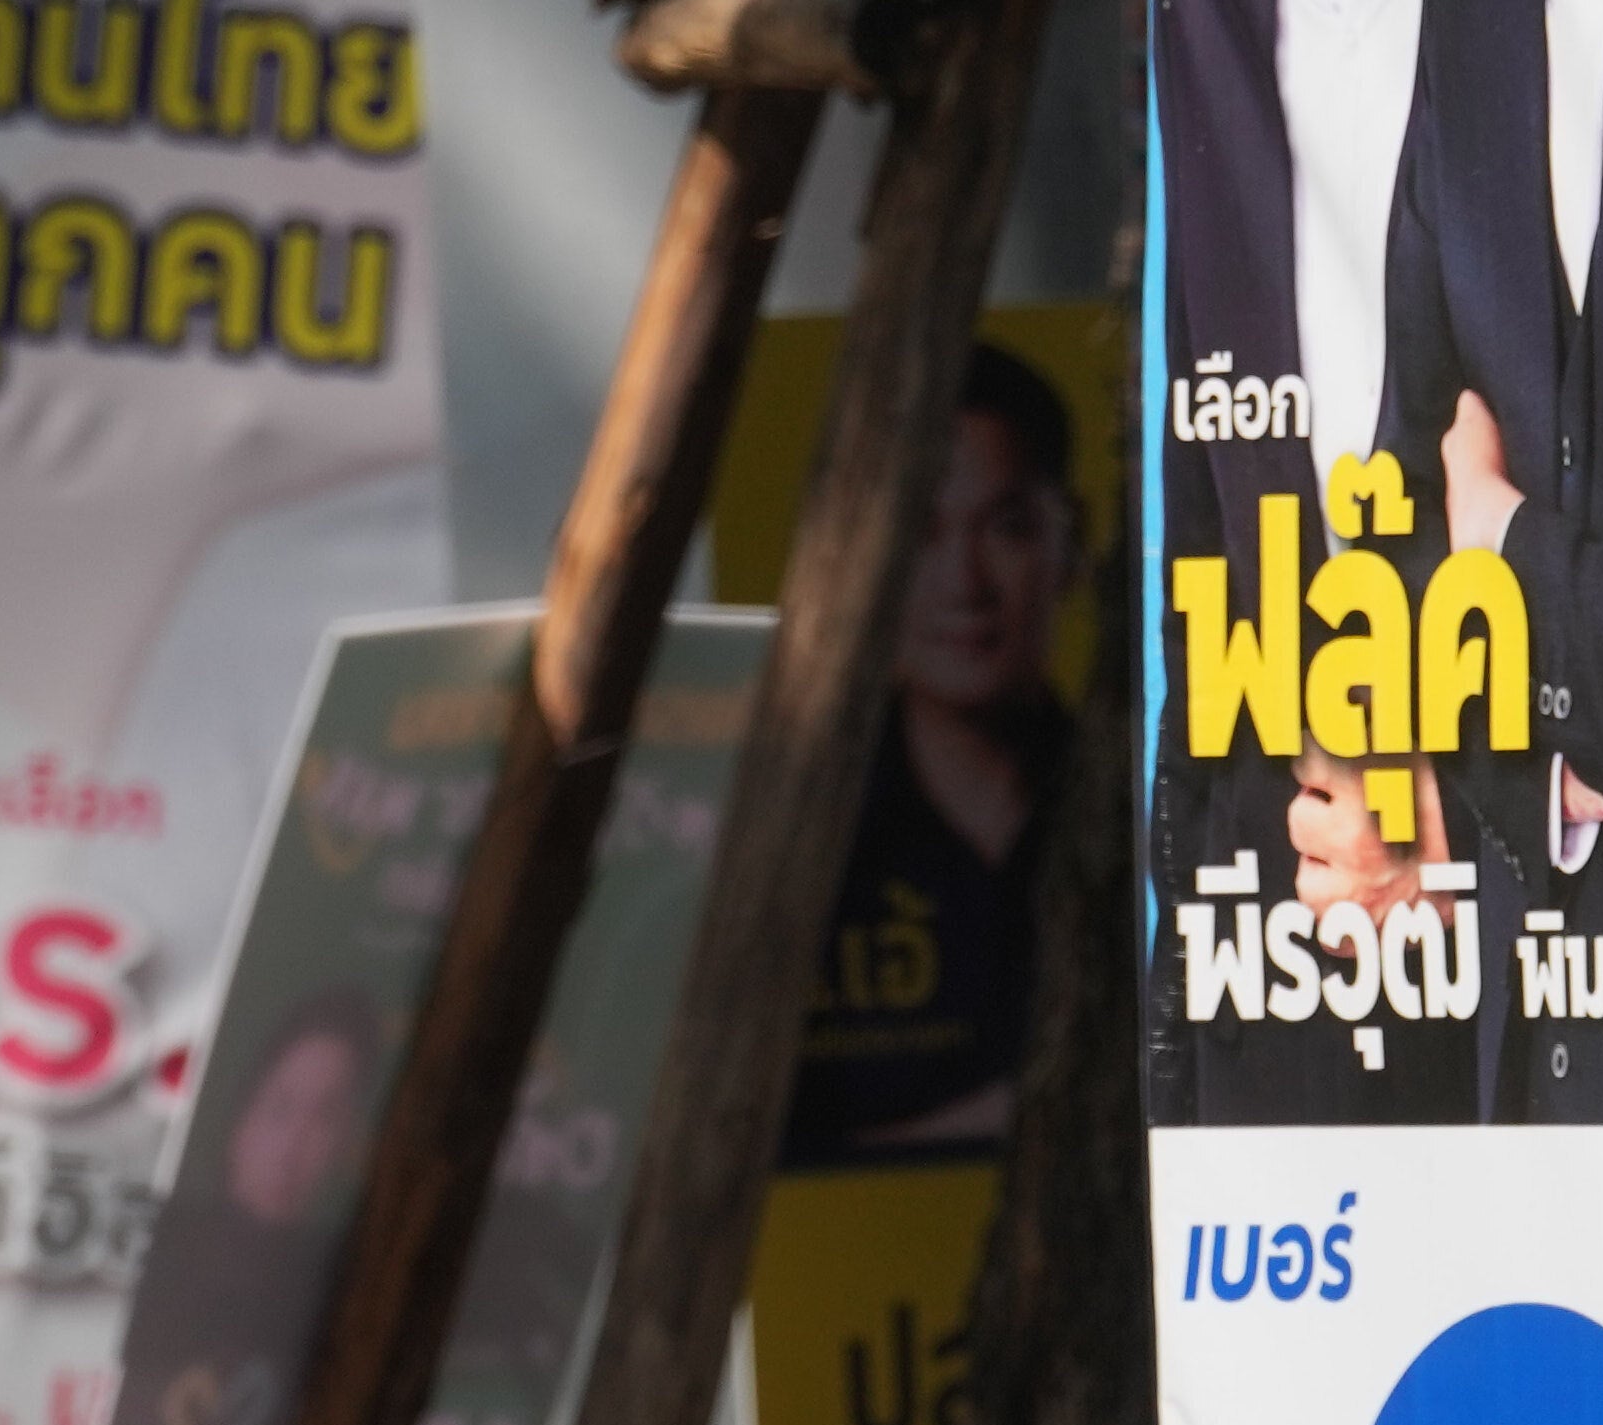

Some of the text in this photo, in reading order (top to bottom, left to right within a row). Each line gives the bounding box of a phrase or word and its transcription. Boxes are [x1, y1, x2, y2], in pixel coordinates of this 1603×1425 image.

[1172, 350, 1312, 442] เลือก
[1172, 449, 1530, 843] ฟลุ๊ค
[1175, 850, 1482, 1070] พีรวุฒิ
[1182, 1190, 1358, 1303] เบอร์
